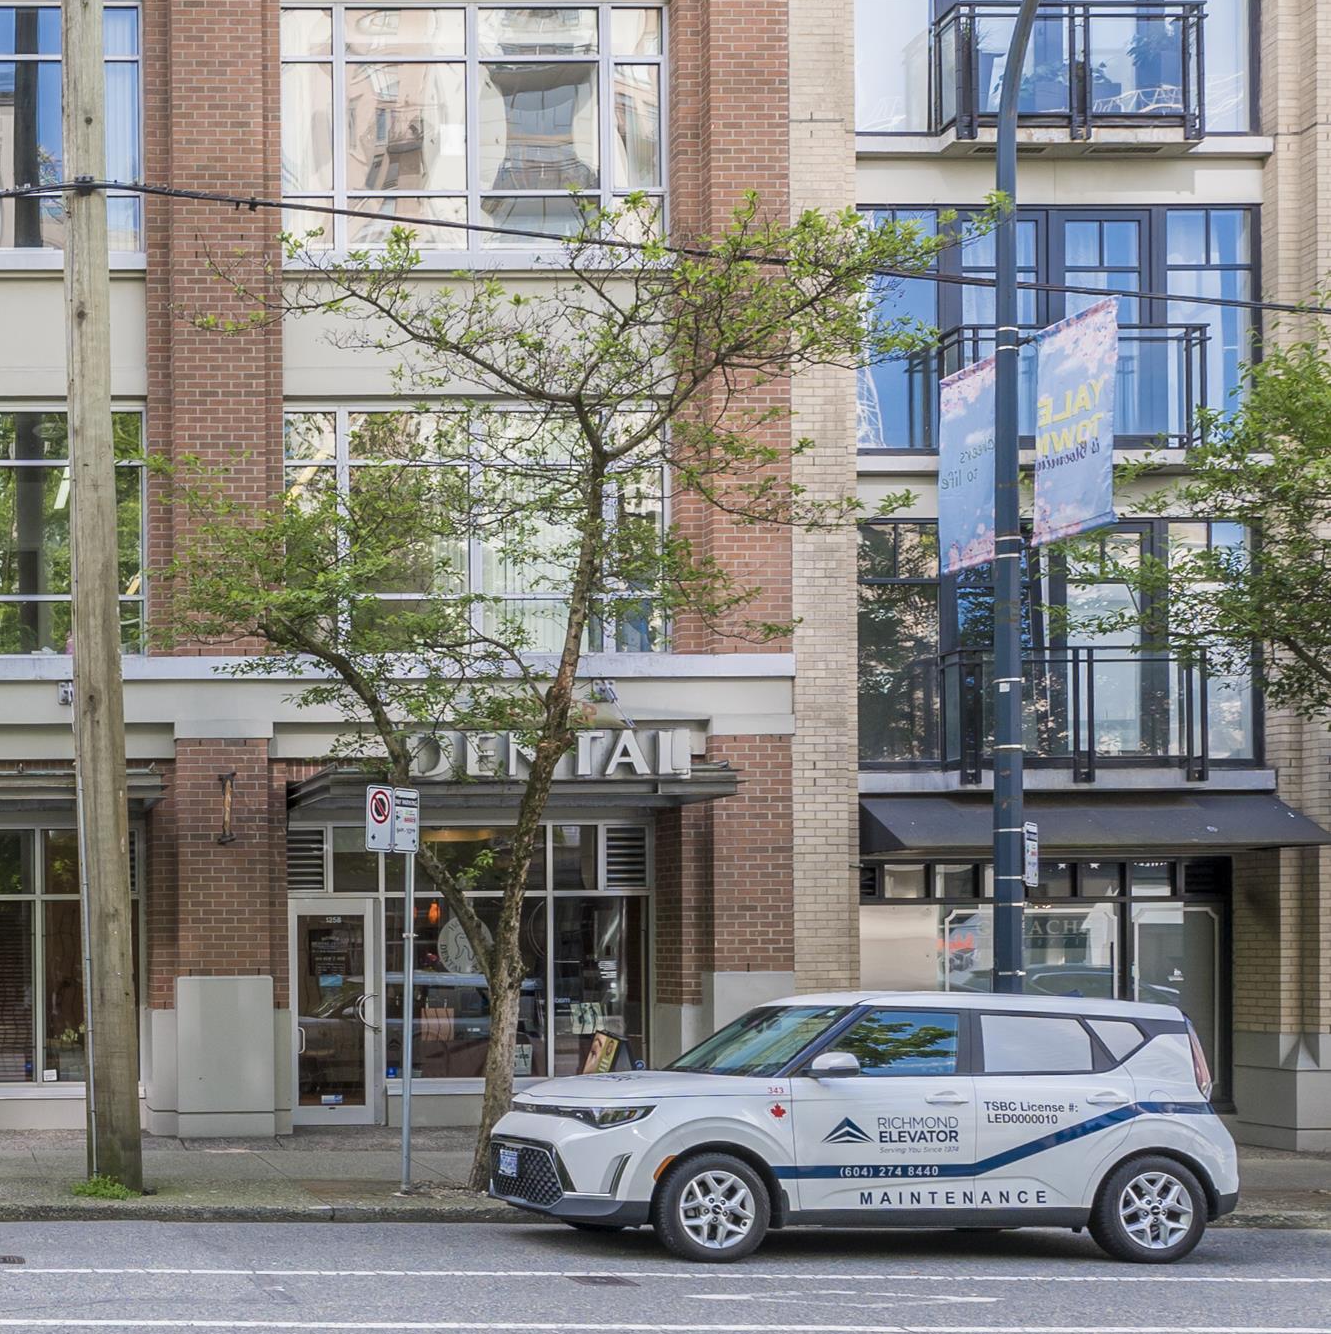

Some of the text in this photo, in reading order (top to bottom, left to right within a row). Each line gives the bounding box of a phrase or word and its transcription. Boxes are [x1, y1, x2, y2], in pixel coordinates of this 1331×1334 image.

[767, 1086, 784, 1094] 343
[983, 1101, 1079, 1113] TSBC License #:
[877, 1116, 959, 1129] RICHMOND
[987, 1113, 1058, 1124] LED0000010
[879, 1130, 959, 1143] ELEVATOR
[879, 1146, 907, 1154] Serving
[839, 1166, 939, 1177] (604) 274 8440
[860, 1190, 1047, 1204] MAINTENANCE
